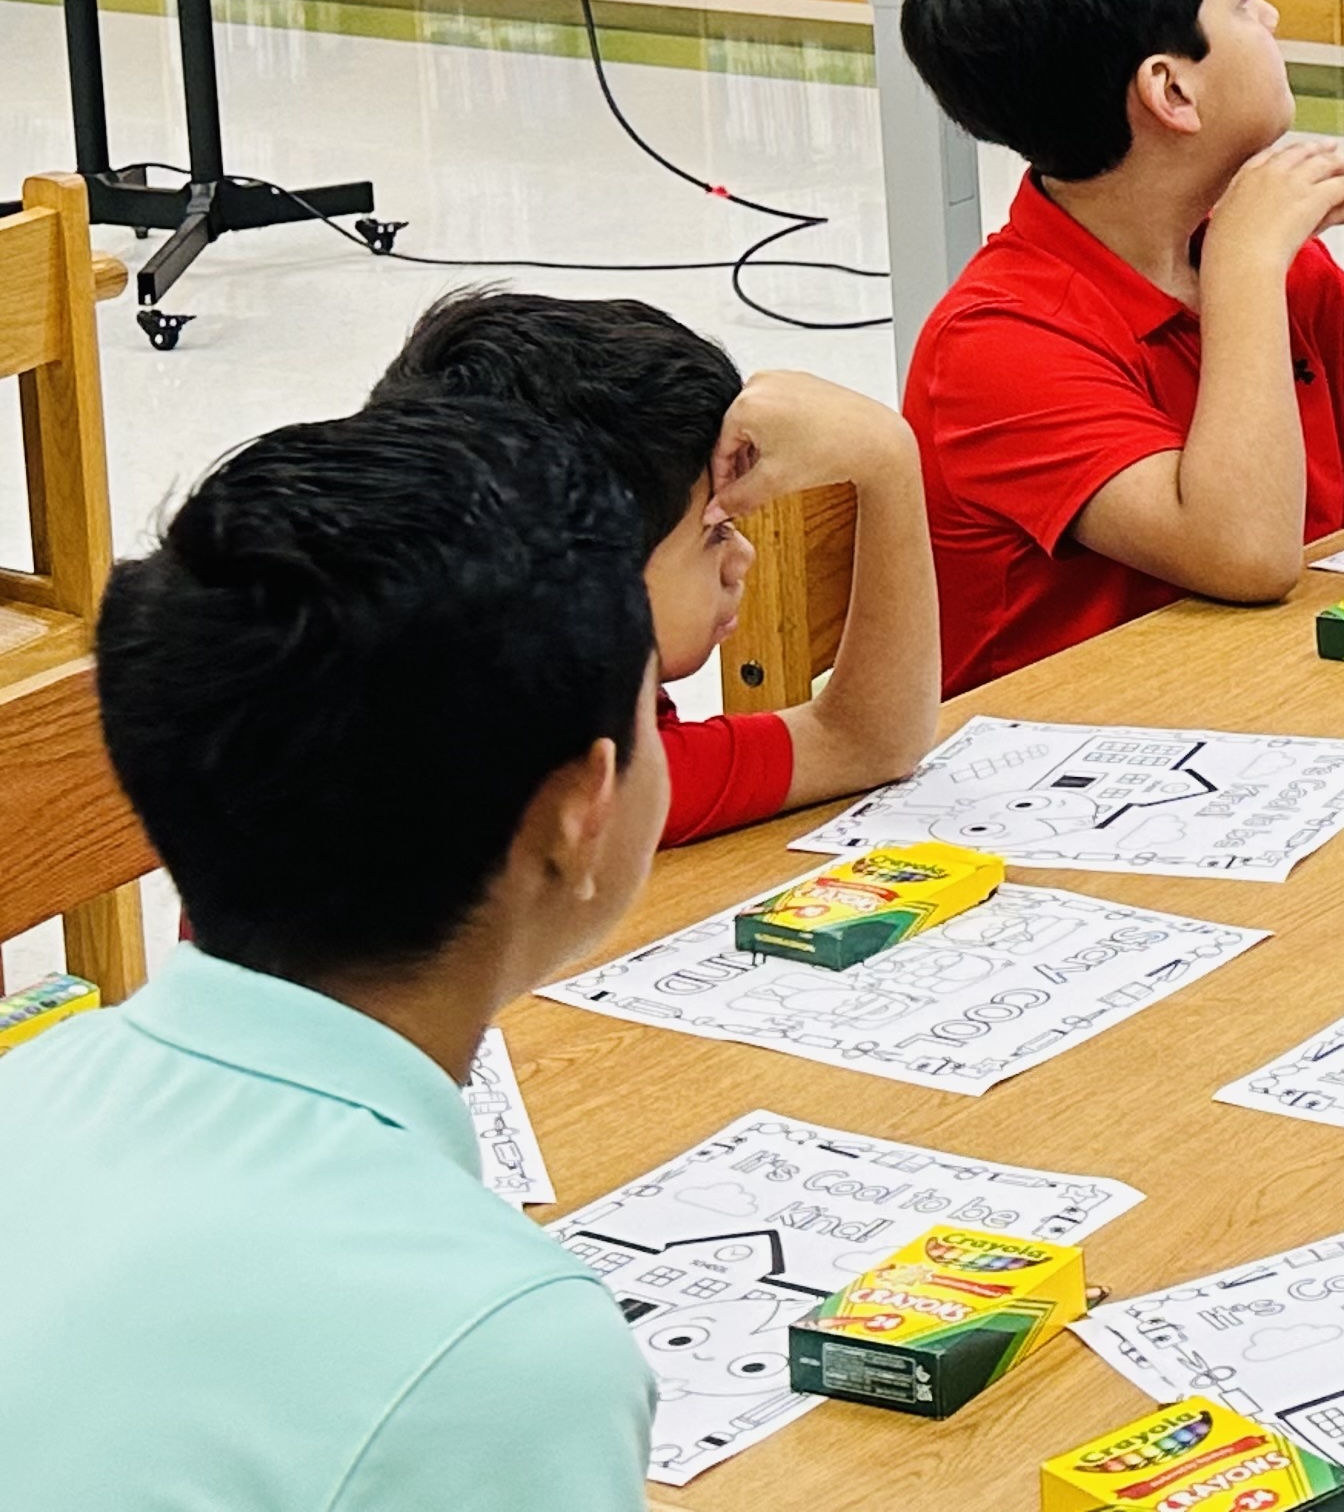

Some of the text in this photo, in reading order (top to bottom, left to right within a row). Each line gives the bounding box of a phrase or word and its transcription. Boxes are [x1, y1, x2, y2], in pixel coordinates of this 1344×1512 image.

[1033, 926, 1169, 984] Stay
[895, 988, 1051, 1048] COOL
[730, 1150, 1020, 1229] It's Cool to be
[765, 1201, 894, 1243] Kind!
[689, 1258, 728, 1275] SCHOOL
[941, 1233, 1045, 1259] Crayola
[850, 1288, 974, 1322] CRAYONS
[1197, 1299, 1285, 1331] It's
[1079, 1410, 1198, 1463] Crayola
[1156, 1451, 1292, 1512] CRAYONS
[1239, 1489, 1277, 1510] 24
